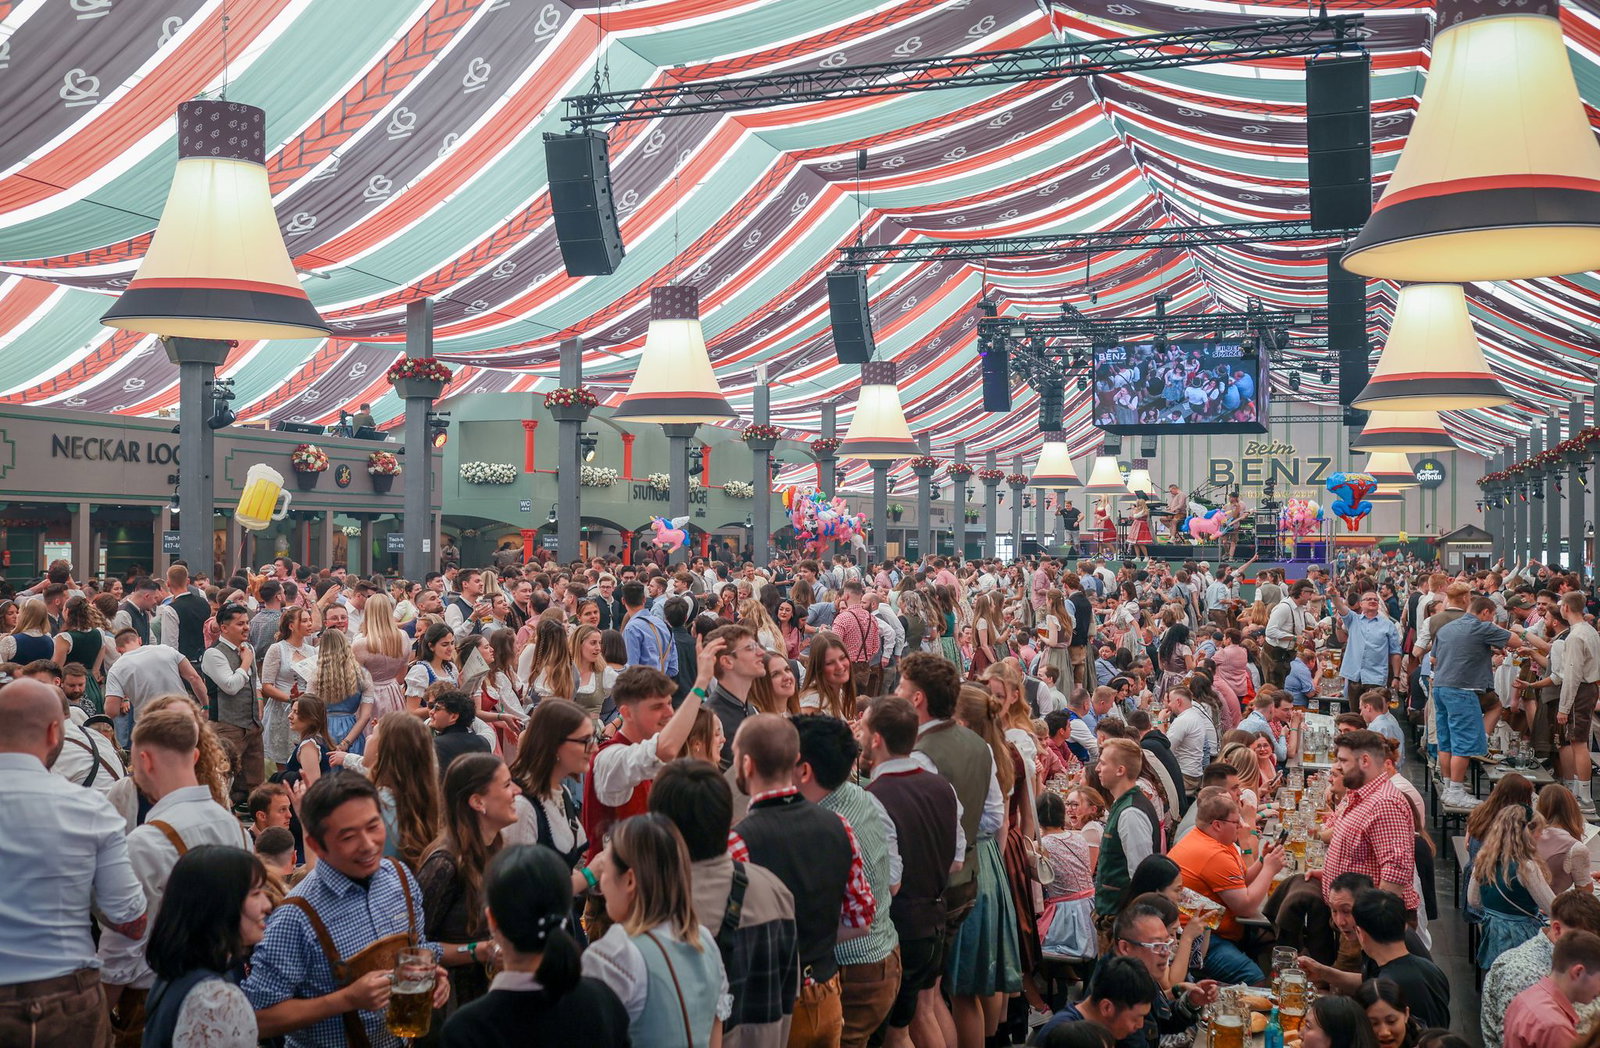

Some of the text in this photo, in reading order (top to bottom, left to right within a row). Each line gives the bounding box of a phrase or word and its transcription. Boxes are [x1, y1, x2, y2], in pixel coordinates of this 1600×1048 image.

[1098, 352, 1127, 361] BENZ
[52, 433, 180, 465] NECKAR LO
[1244, 440, 1296, 456] Beim
[1209, 457, 1332, 486] BENZ
[687, 490, 708, 505] OGE
